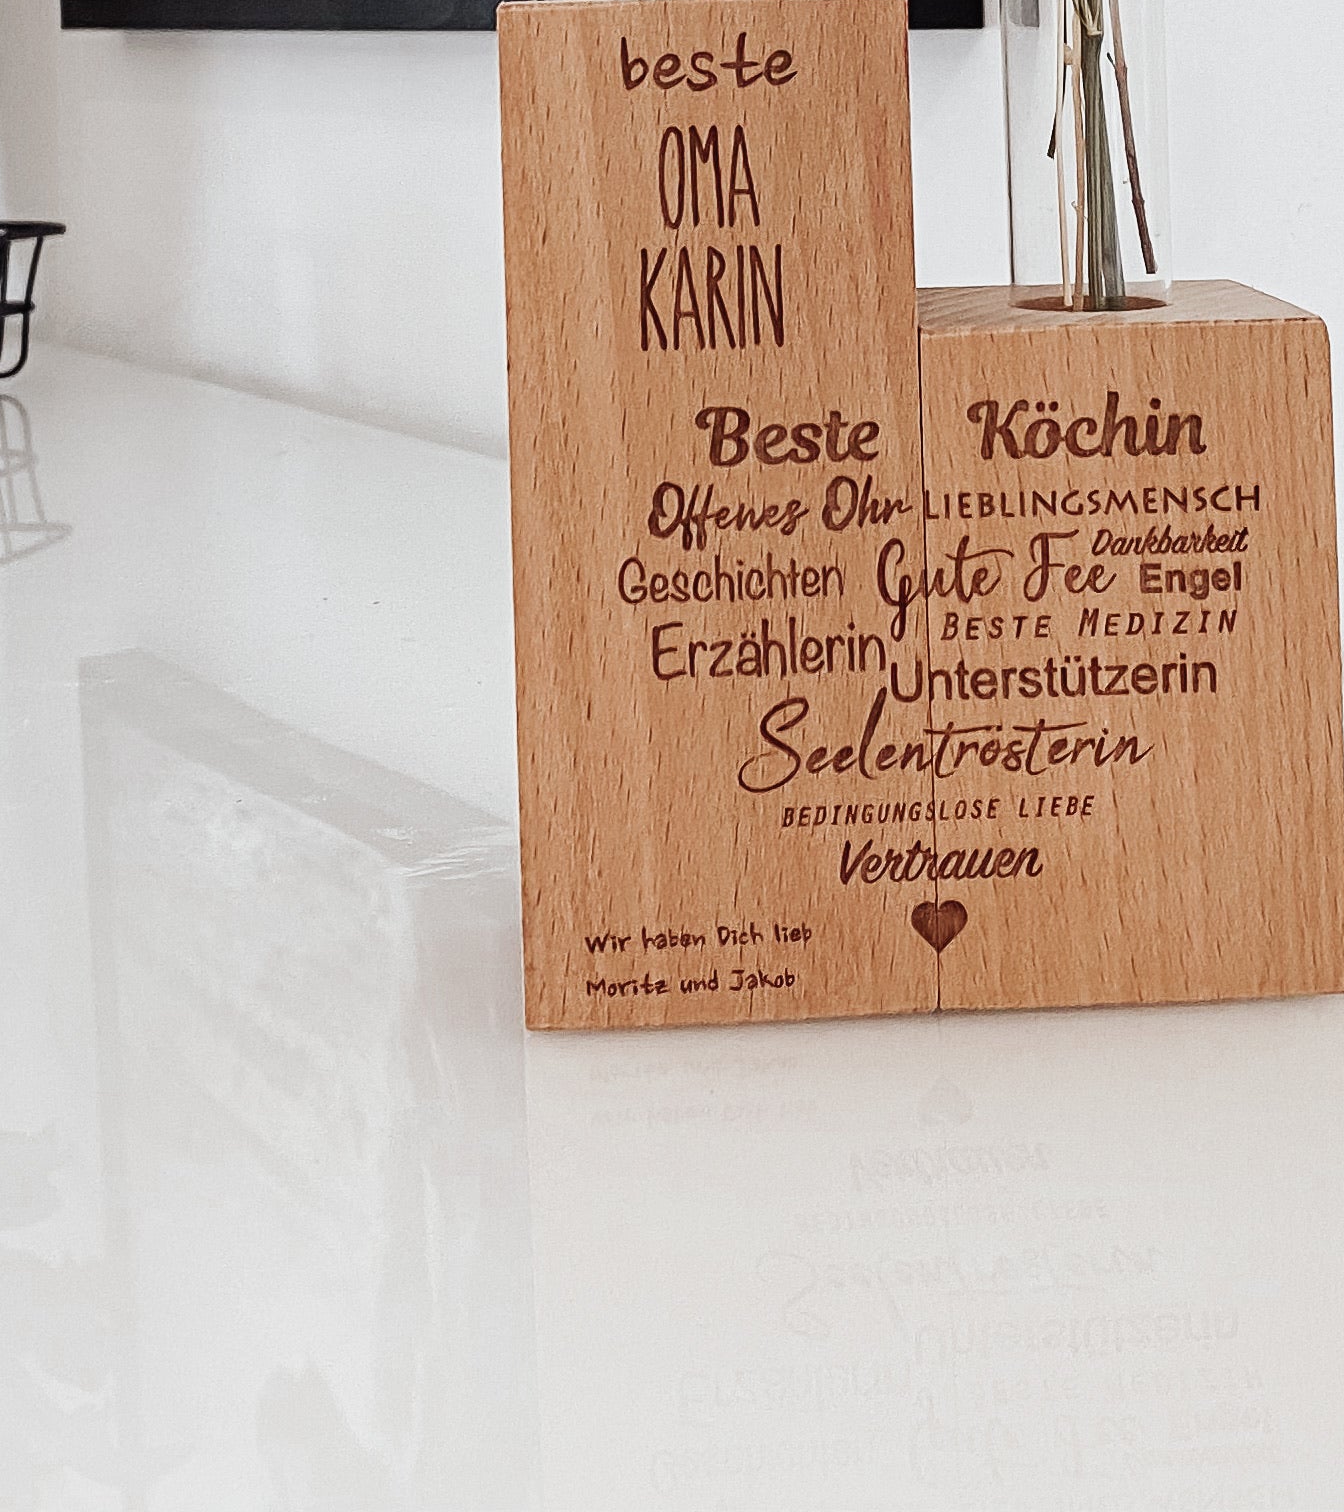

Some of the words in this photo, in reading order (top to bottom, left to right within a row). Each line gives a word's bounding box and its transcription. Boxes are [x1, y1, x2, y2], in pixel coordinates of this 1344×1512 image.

[619, 32, 798, 90] beste
[658, 124, 761, 230] OMA
[639, 244, 785, 351] KARIN
[695, 406, 880, 468] Beste
[966, 391, 1207, 460] Köchin
[649, 482, 810, 551] Offenes
[821, 475, 913, 532] Ohr
[922, 485, 1261, 520] LIEBLINGSMENSCH
[1091, 525, 1249, 557] Dankbarkeit
[618, 553, 845, 605] Geschichten
[877, 536, 1014, 641] Gute
[1022, 529, 1117, 599] Fee
[1140, 562, 1243, 598] Engel
[1078, 608, 1239, 637] MEDIZIN
[652, 616, 886, 681] Erzählerin
[890, 653, 1218, 703] Unterstützerin
[738, 688, 1155, 794] Seelentrösterin
[781, 799, 1001, 828] BEDINGUNGSLOSE
[1019, 794, 1096, 819] LIEBE
[839, 839, 1044, 885] Vertrauen
[585, 932, 632, 955] Wir
[642, 925, 707, 950] haben
[718, 923, 763, 947] Dich
[775, 923, 813, 945] lieb
[586, 972, 668, 997] Moritz
[680, 969, 719, 993] und
[730, 968, 796, 992] Jakob
